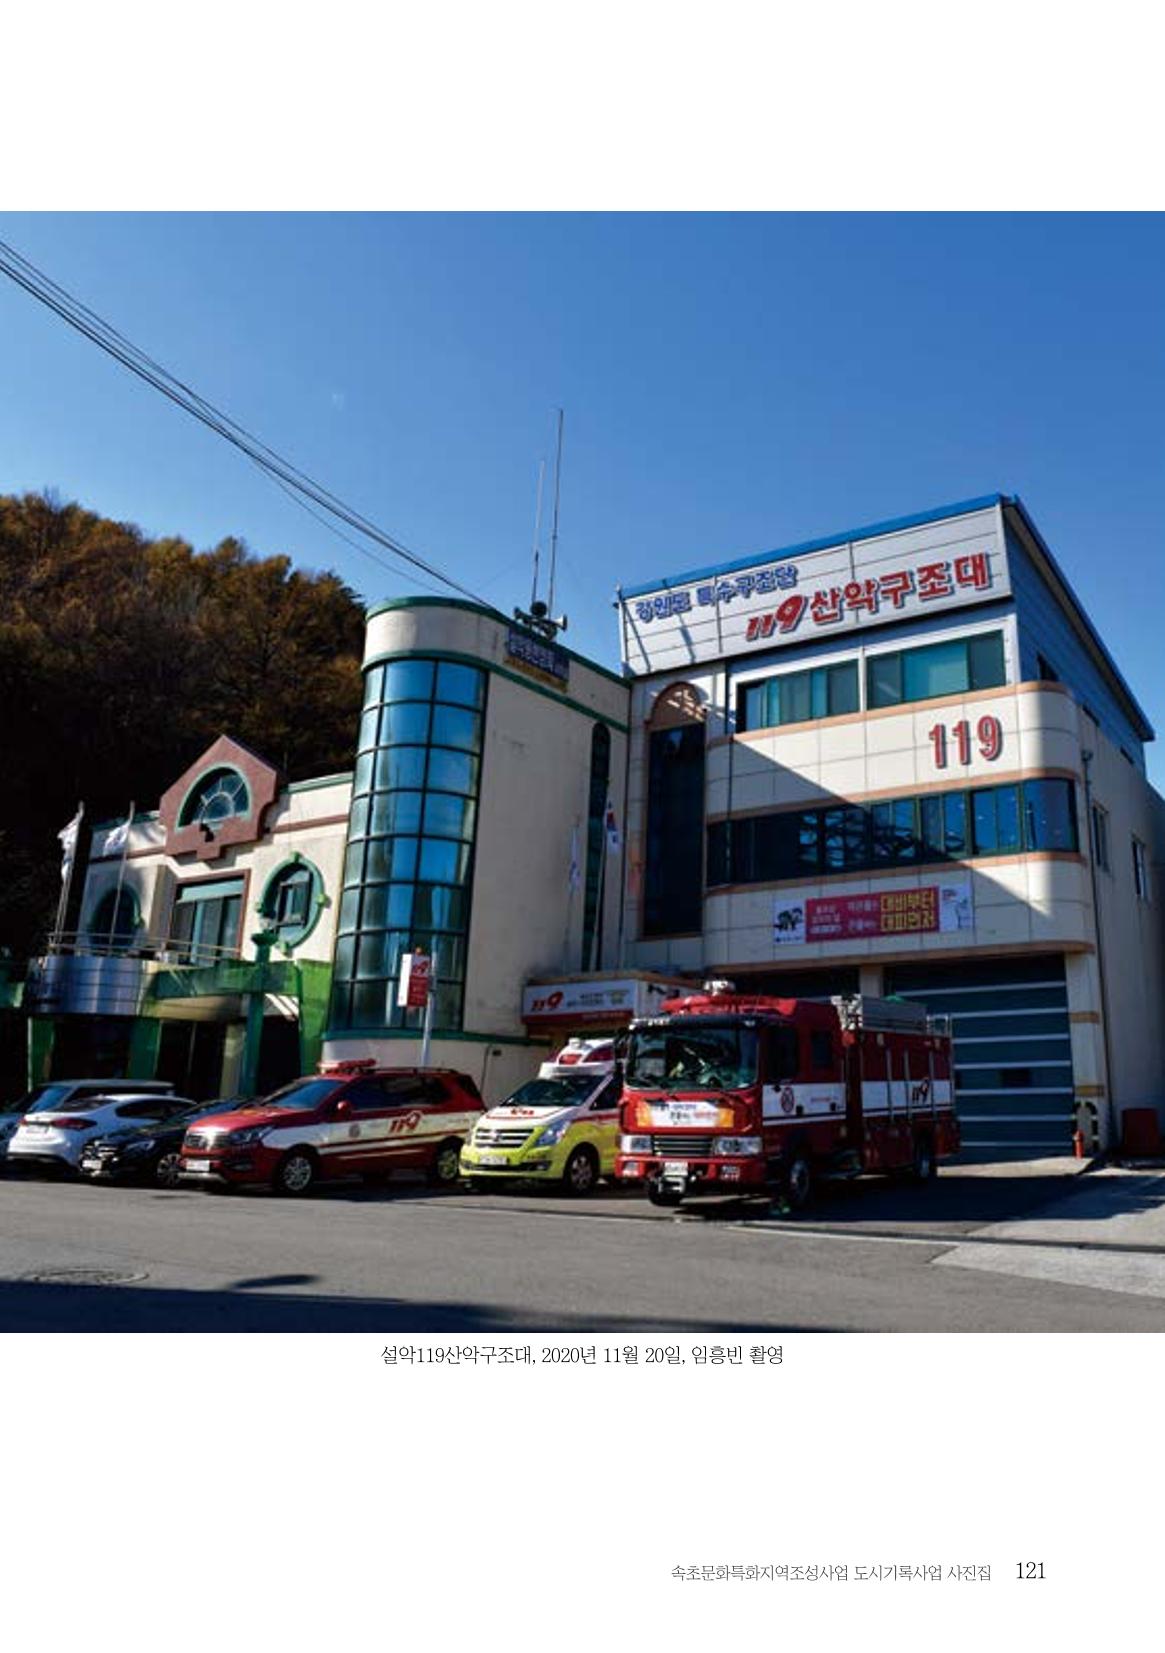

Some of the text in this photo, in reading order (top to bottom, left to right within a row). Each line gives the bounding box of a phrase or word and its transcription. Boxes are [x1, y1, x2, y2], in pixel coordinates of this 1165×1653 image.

[635, 565, 798, 623] 강원도 특수구조단
[745, 551, 993, 641] 119 산악구조대
[928, 714, 1004, 769] 119
[530, 990, 565, 1012] 119
[388, 1110, 423, 1134] 119
